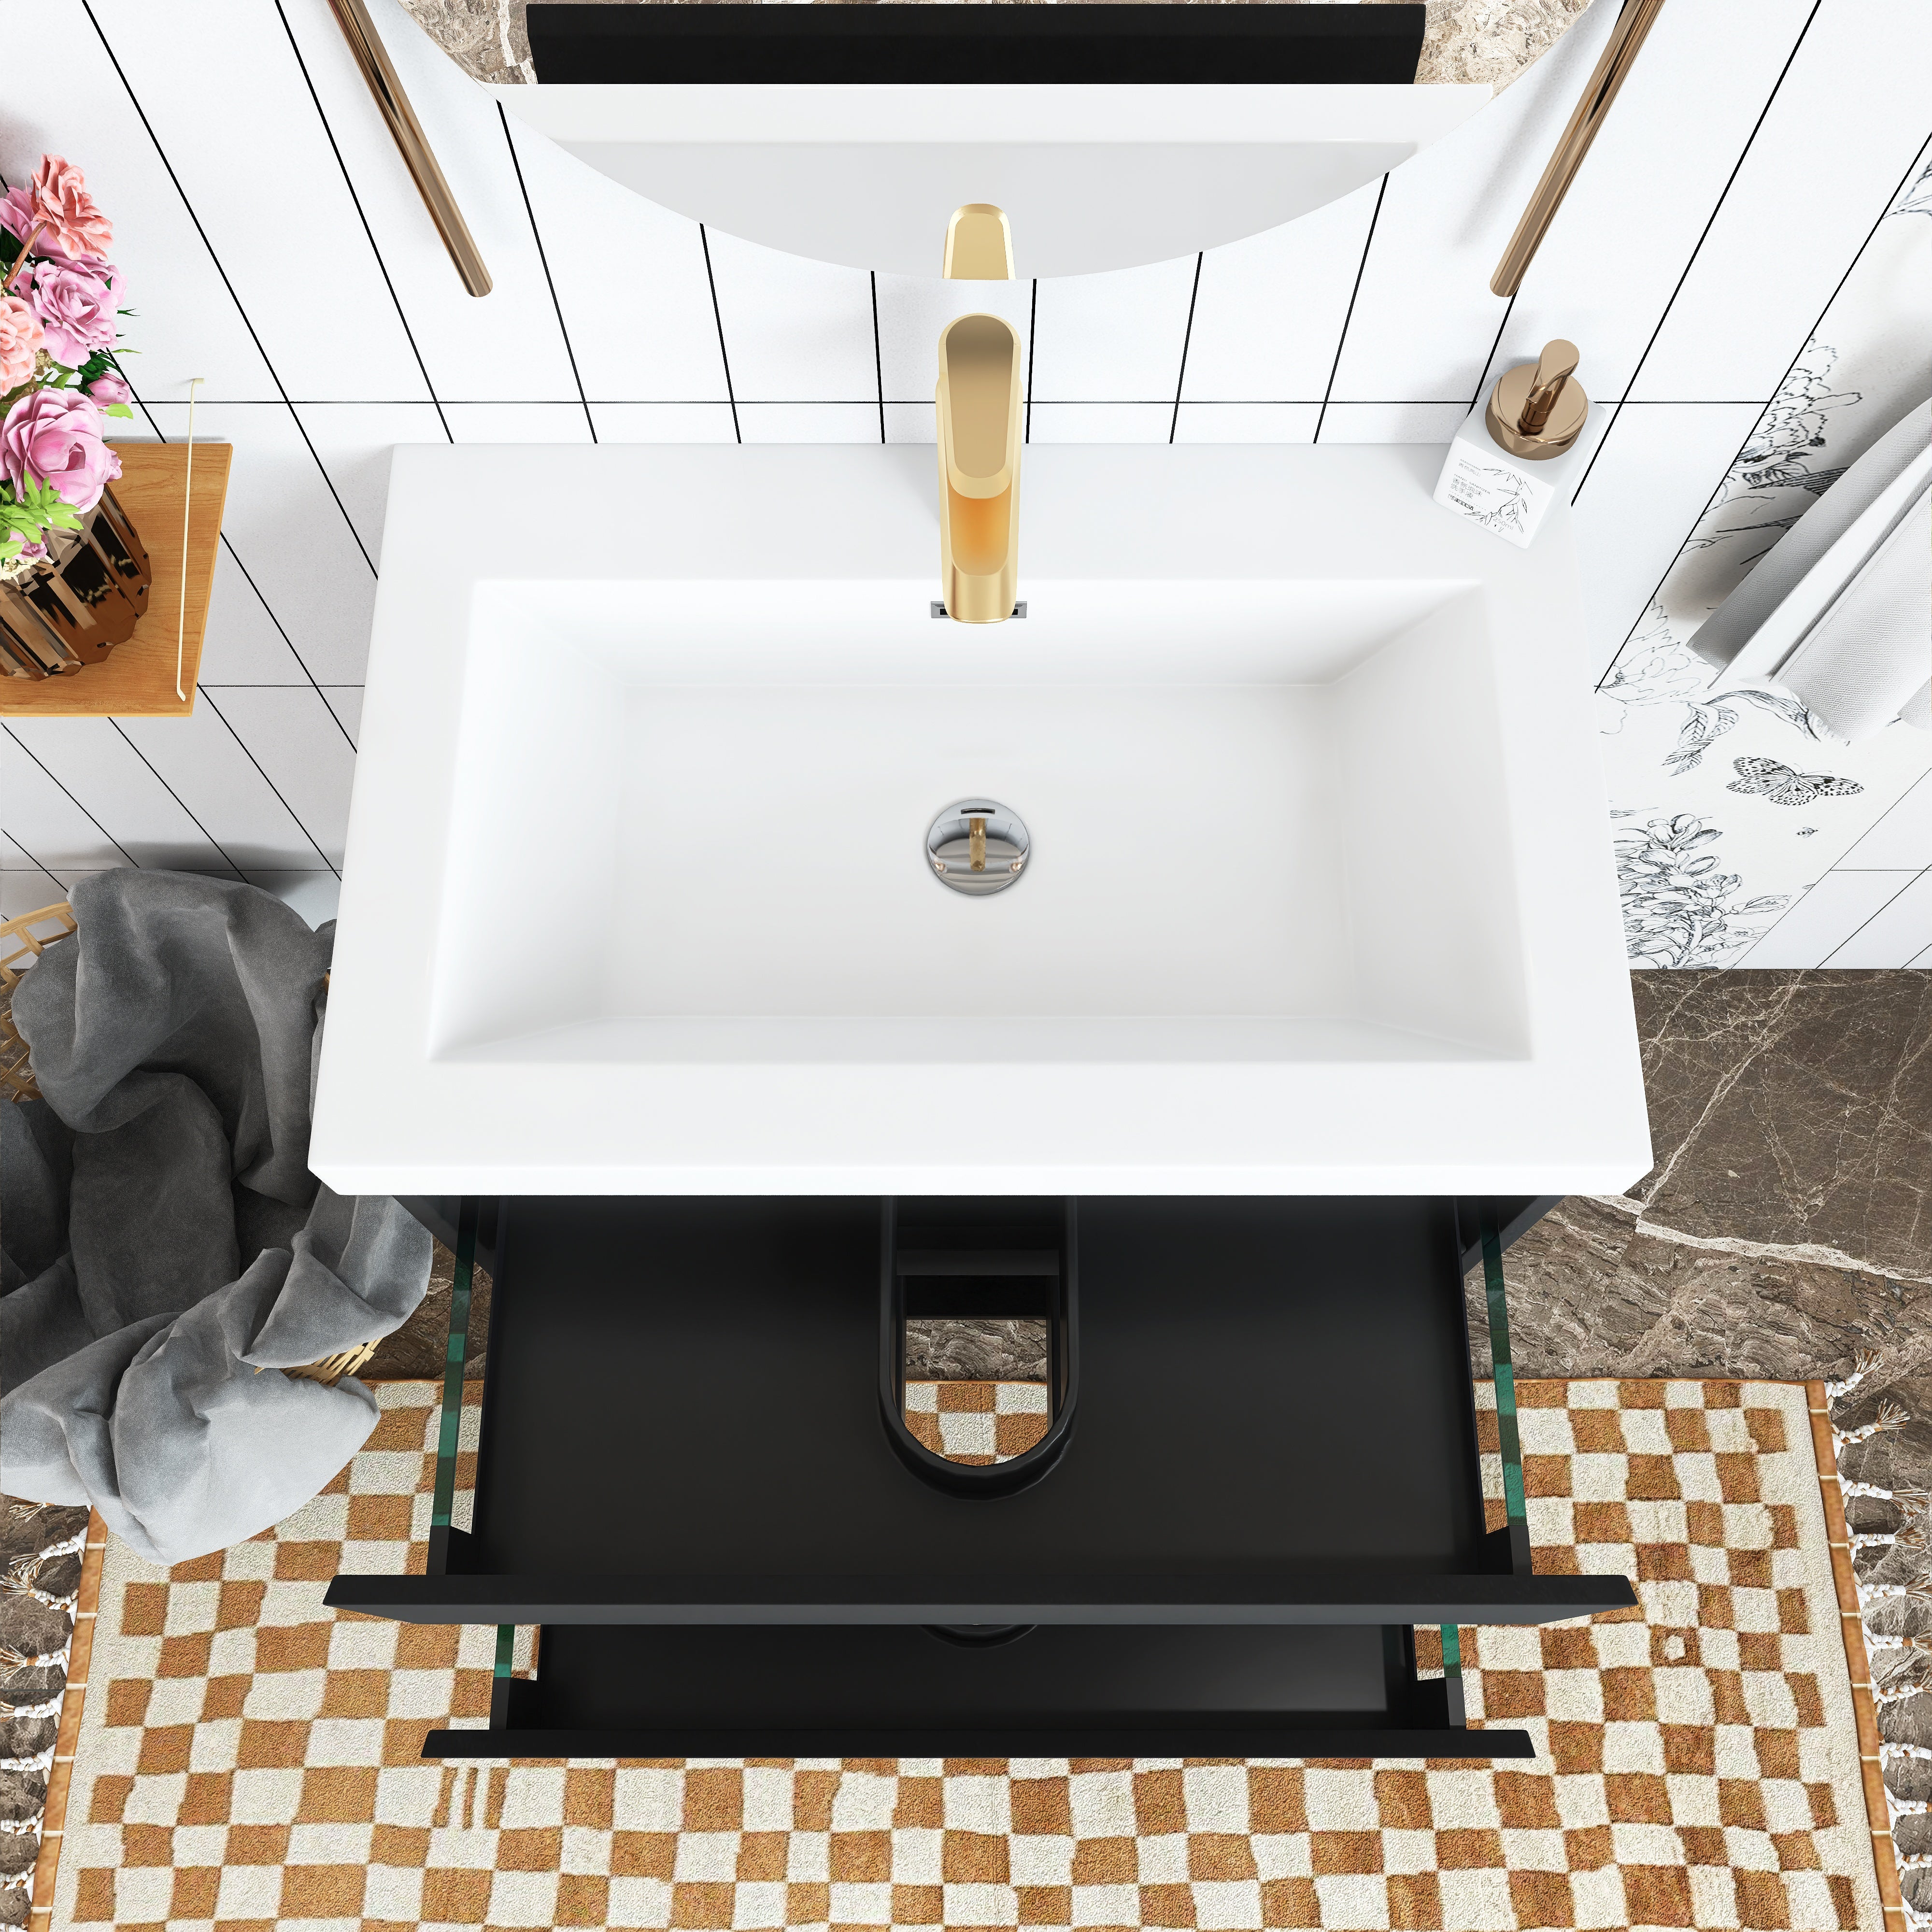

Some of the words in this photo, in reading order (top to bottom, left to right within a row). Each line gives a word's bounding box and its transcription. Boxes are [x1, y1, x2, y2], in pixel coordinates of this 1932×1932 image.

[1450, 483, 1474, 499] 洗手液
[1469, 482, 1491, 495] SANITIZER
[1493, 516, 1514, 530] 250ml
